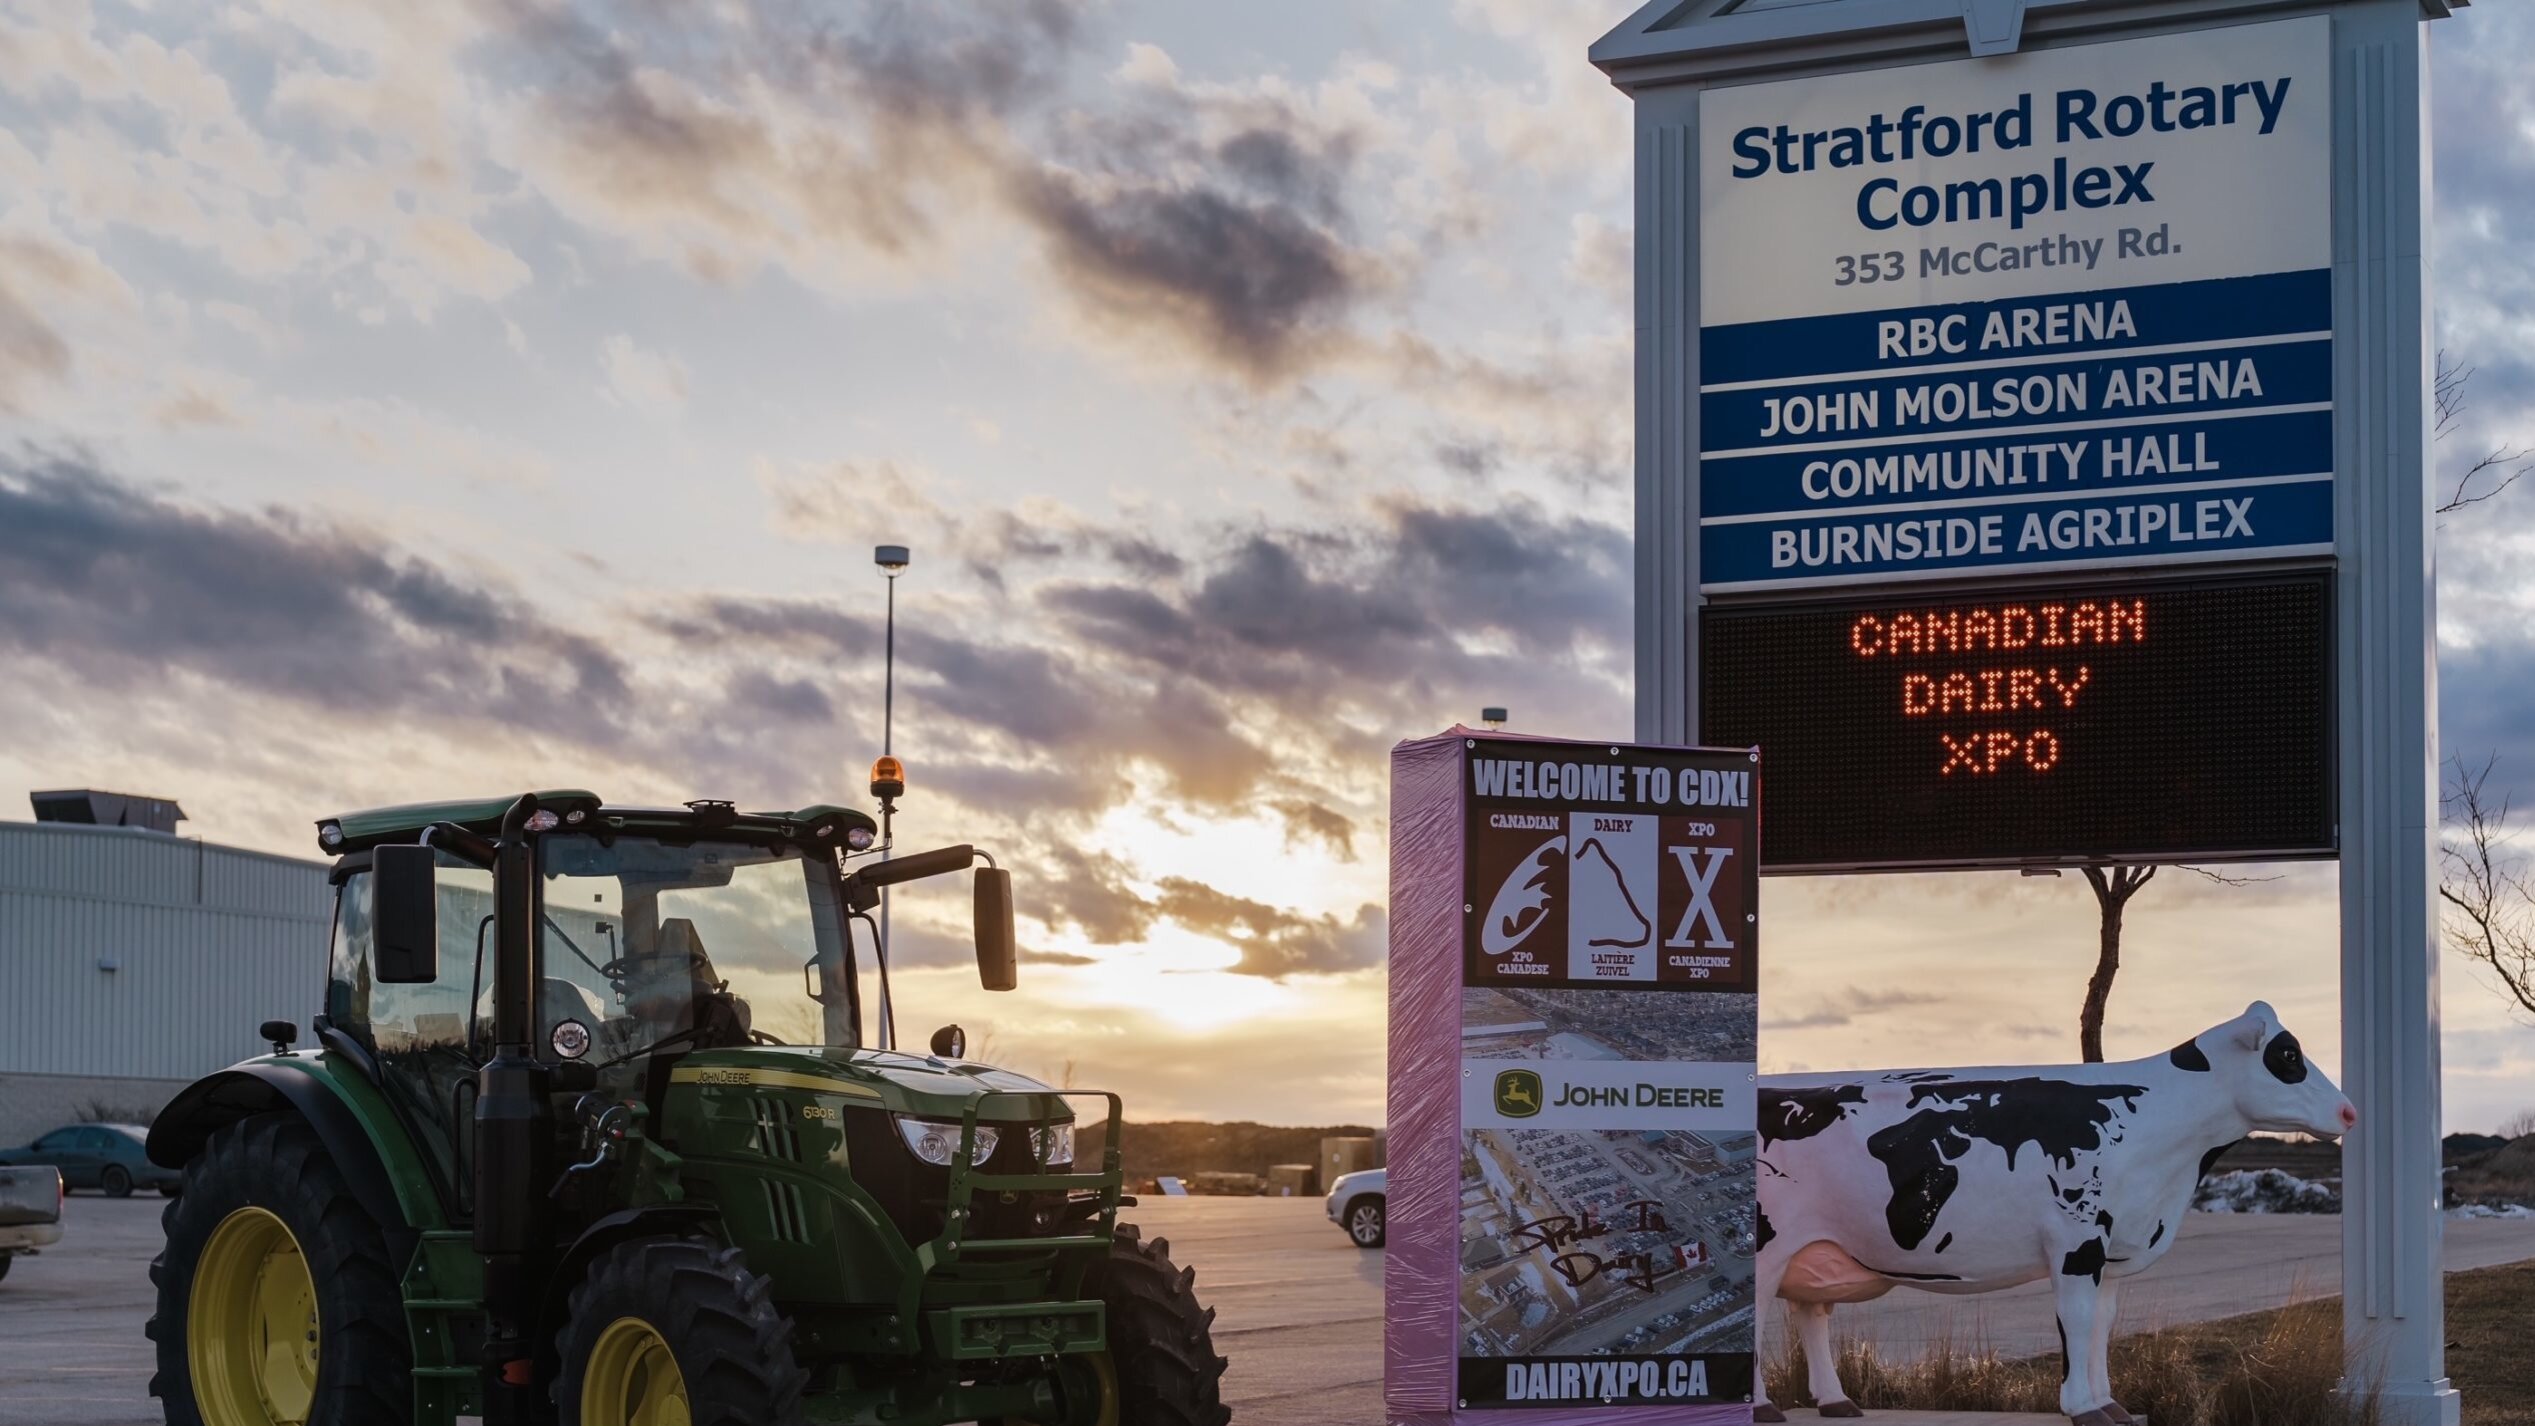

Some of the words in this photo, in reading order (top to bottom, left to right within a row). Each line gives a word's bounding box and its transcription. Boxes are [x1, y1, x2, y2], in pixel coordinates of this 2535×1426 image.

[1732, 94, 2032, 179] Stratford
[2056, 77, 2292, 143] Rotary
[1856, 158, 2155, 230] Complex
[1834, 252, 1905, 287] 353
[1919, 235, 2104, 280] McCarthy
[2117, 223, 2182, 260] Rd.
[1878, 314, 1967, 359] RBC
[1979, 300, 2137, 350] ARENA
[1760, 392, 1879, 438] JOHN
[1895, 371, 2088, 426] MOLSON
[2102, 358, 2263, 409] ARENA
[1801, 441, 2088, 499] COMMUNITY
[2102, 432, 2220, 478] HALL
[1771, 514, 2003, 569] BURNSIDE
[2017, 497, 2255, 552] AGRIPLEX
[1851, 599, 2145, 656] CANADIAN
[1905, 666, 2090, 715] DAIRY
[1941, 730, 2059, 775] XPO
[1473, 758, 1625, 801] WELCOME
[1632, 766, 1671, 804] TO
[1678, 769, 1750, 807] CDX!
[1490, 814, 1559, 830] CANADIAN
[1594, 818, 1633, 833] DAIRY
[1688, 822, 1715, 837] XPO
[1497, 963, 1549, 975] CANADESE
[1512, 952, 1534, 963] XPO
[1596, 966, 1630, 976] ZUIVEL
[1669, 956, 1731, 967] CANADIENNE
[1689, 968, 1710, 979] XPO
[697, 1070, 721, 1084] JOHN
[720, 1070, 751, 1085] DEERE
[1553, 1082, 1629, 1107] JOHN
[1636, 1083, 1725, 1108] DEERE
[1506, 1360, 1709, 1401] DAIRYXPO.CA
